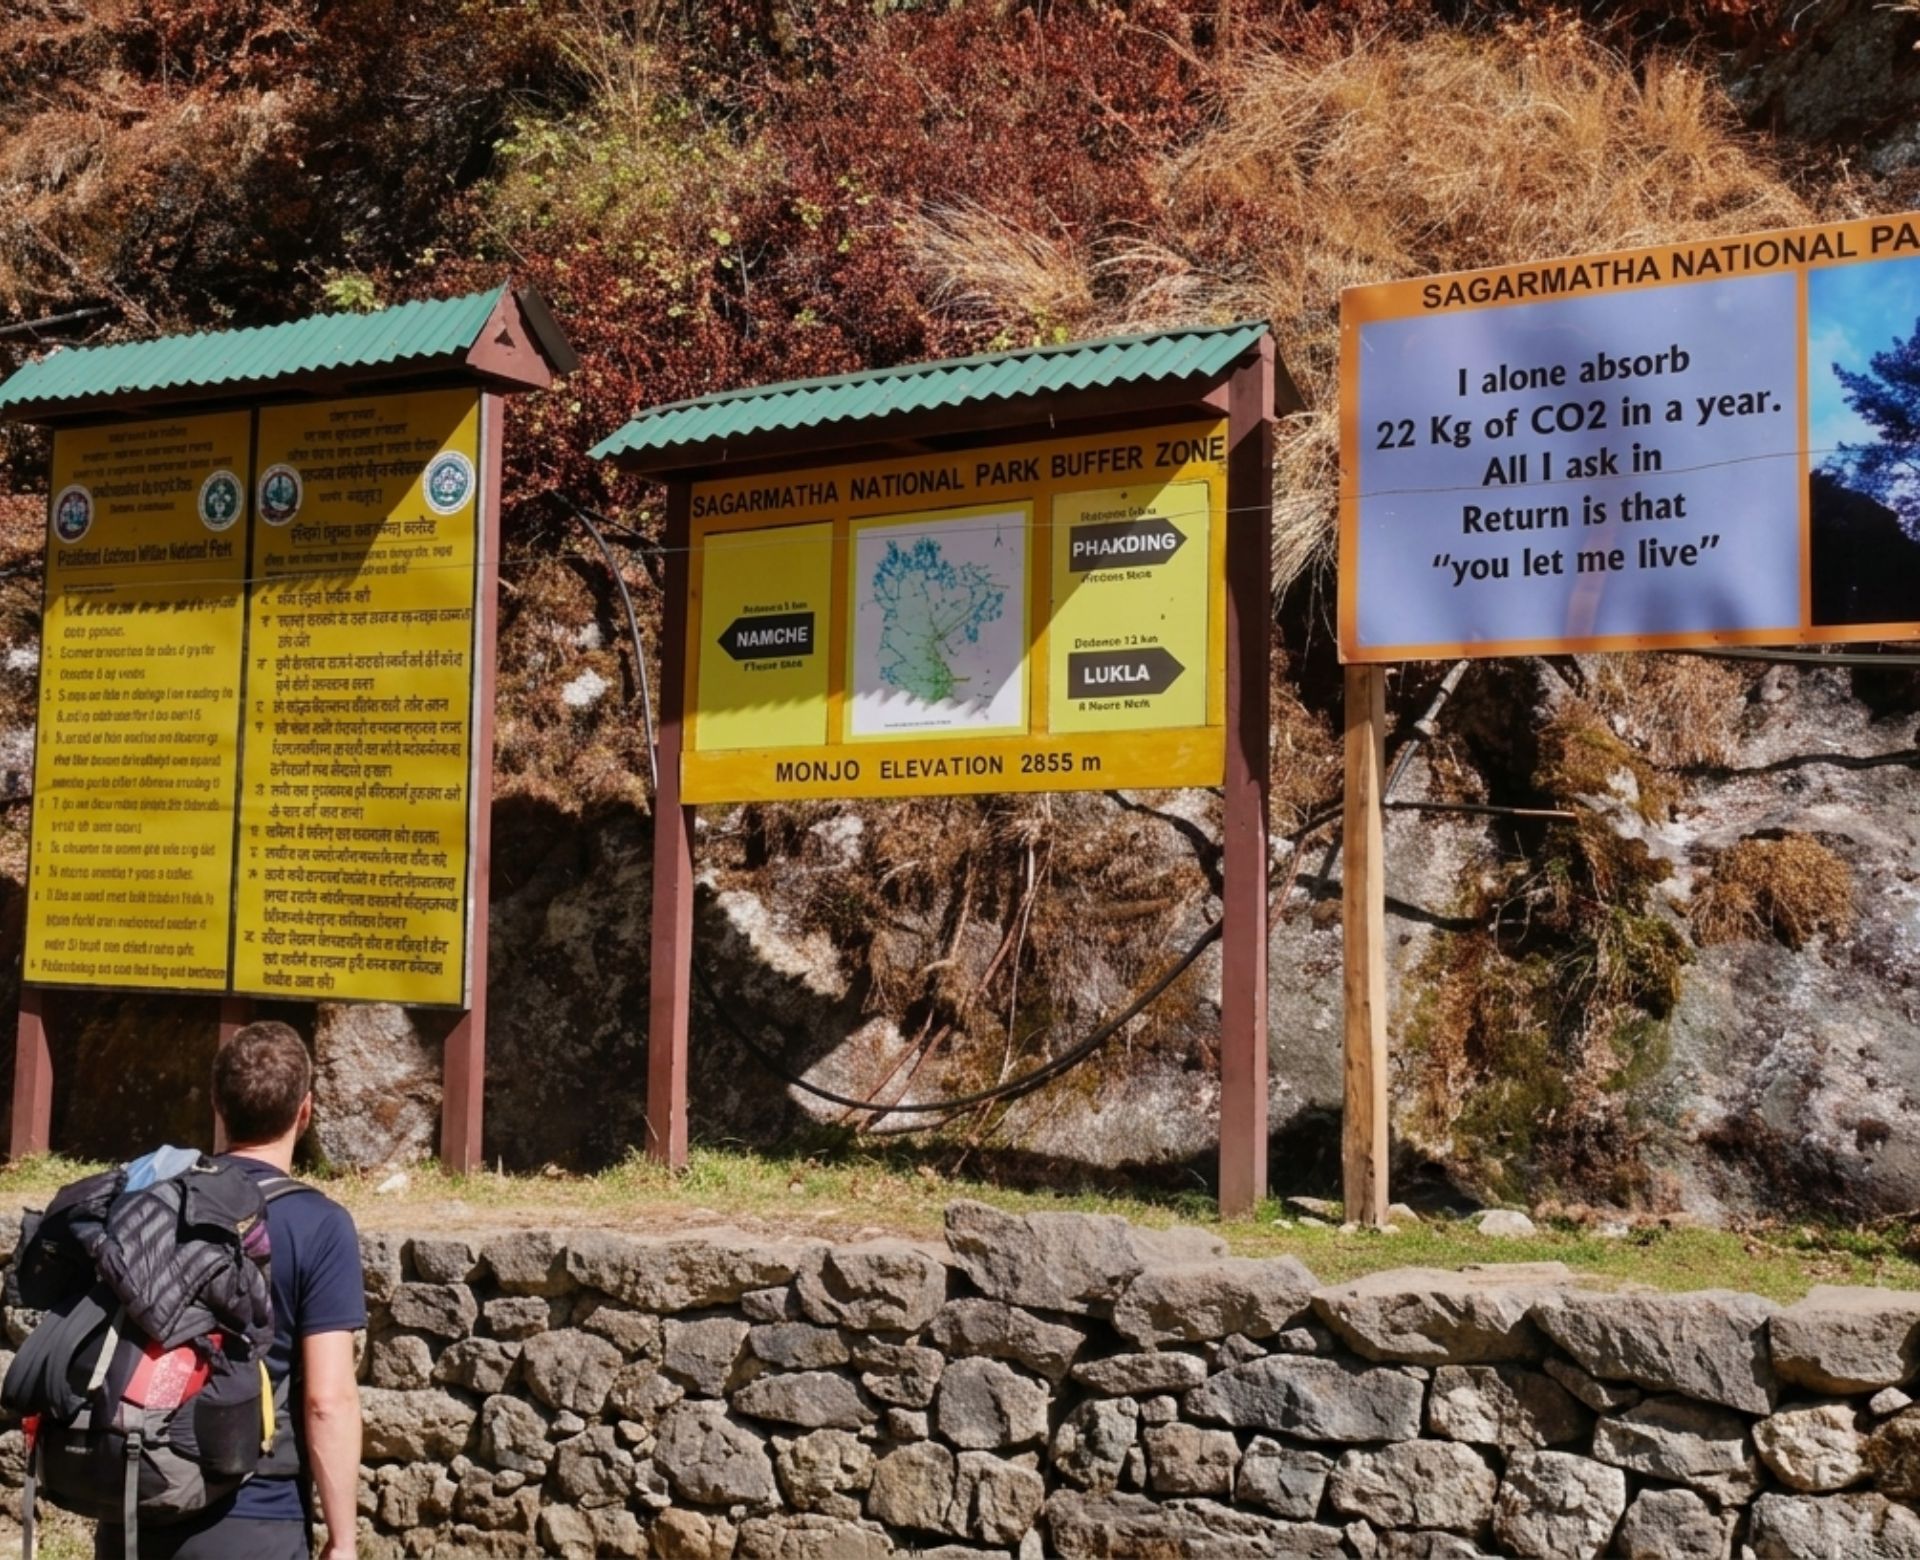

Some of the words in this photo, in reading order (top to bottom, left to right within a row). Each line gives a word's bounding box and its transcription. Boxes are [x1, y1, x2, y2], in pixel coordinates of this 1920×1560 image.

[1423, 255, 1661, 309] SAGARMATHA
[1672, 231, 1858, 278] NATIONAL
[1871, 222, 1920, 254] PA
[1459, 368, 1467, 396] I
[1482, 363, 1566, 394] alone
[1579, 344, 1690, 383] absorb
[1377, 419, 1415, 450] 22
[1431, 414, 1472, 449] Kg
[1484, 408, 1519, 439] of
[1531, 400, 1607, 435] CO2
[1622, 396, 1651, 427] in
[1665, 400, 1682, 423] a
[1696, 390, 1781, 426] year.
[692, 481, 839, 518] SAGARMATHA
[851, 467, 964, 502] NATIONAL
[976, 457, 1040, 486] PARK
[1051, 445, 1143, 478] BUFFER
[1155, 435, 1225, 467] ZONE
[1482, 454, 1527, 486] All
[1543, 452, 1550, 481] I
[1566, 447, 1618, 479] ask
[1632, 443, 1662, 472] in
[1463, 505, 1569, 534] Return
[1583, 495, 1606, 525] is
[1621, 491, 1687, 522] that
[1073, 532, 1177, 558] PHAKDING
[1524, 548, 1563, 576] let
[1577, 549, 1625, 573] me
[736, 626, 808, 648] NAMCHE
[1084, 664, 1150, 684] LUKLA
[776, 760, 860, 782] MONJO
[880, 756, 1003, 779] ELEVATION
[1021, 752, 1073, 773] 2855
[1082, 756, 1101, 771] m
